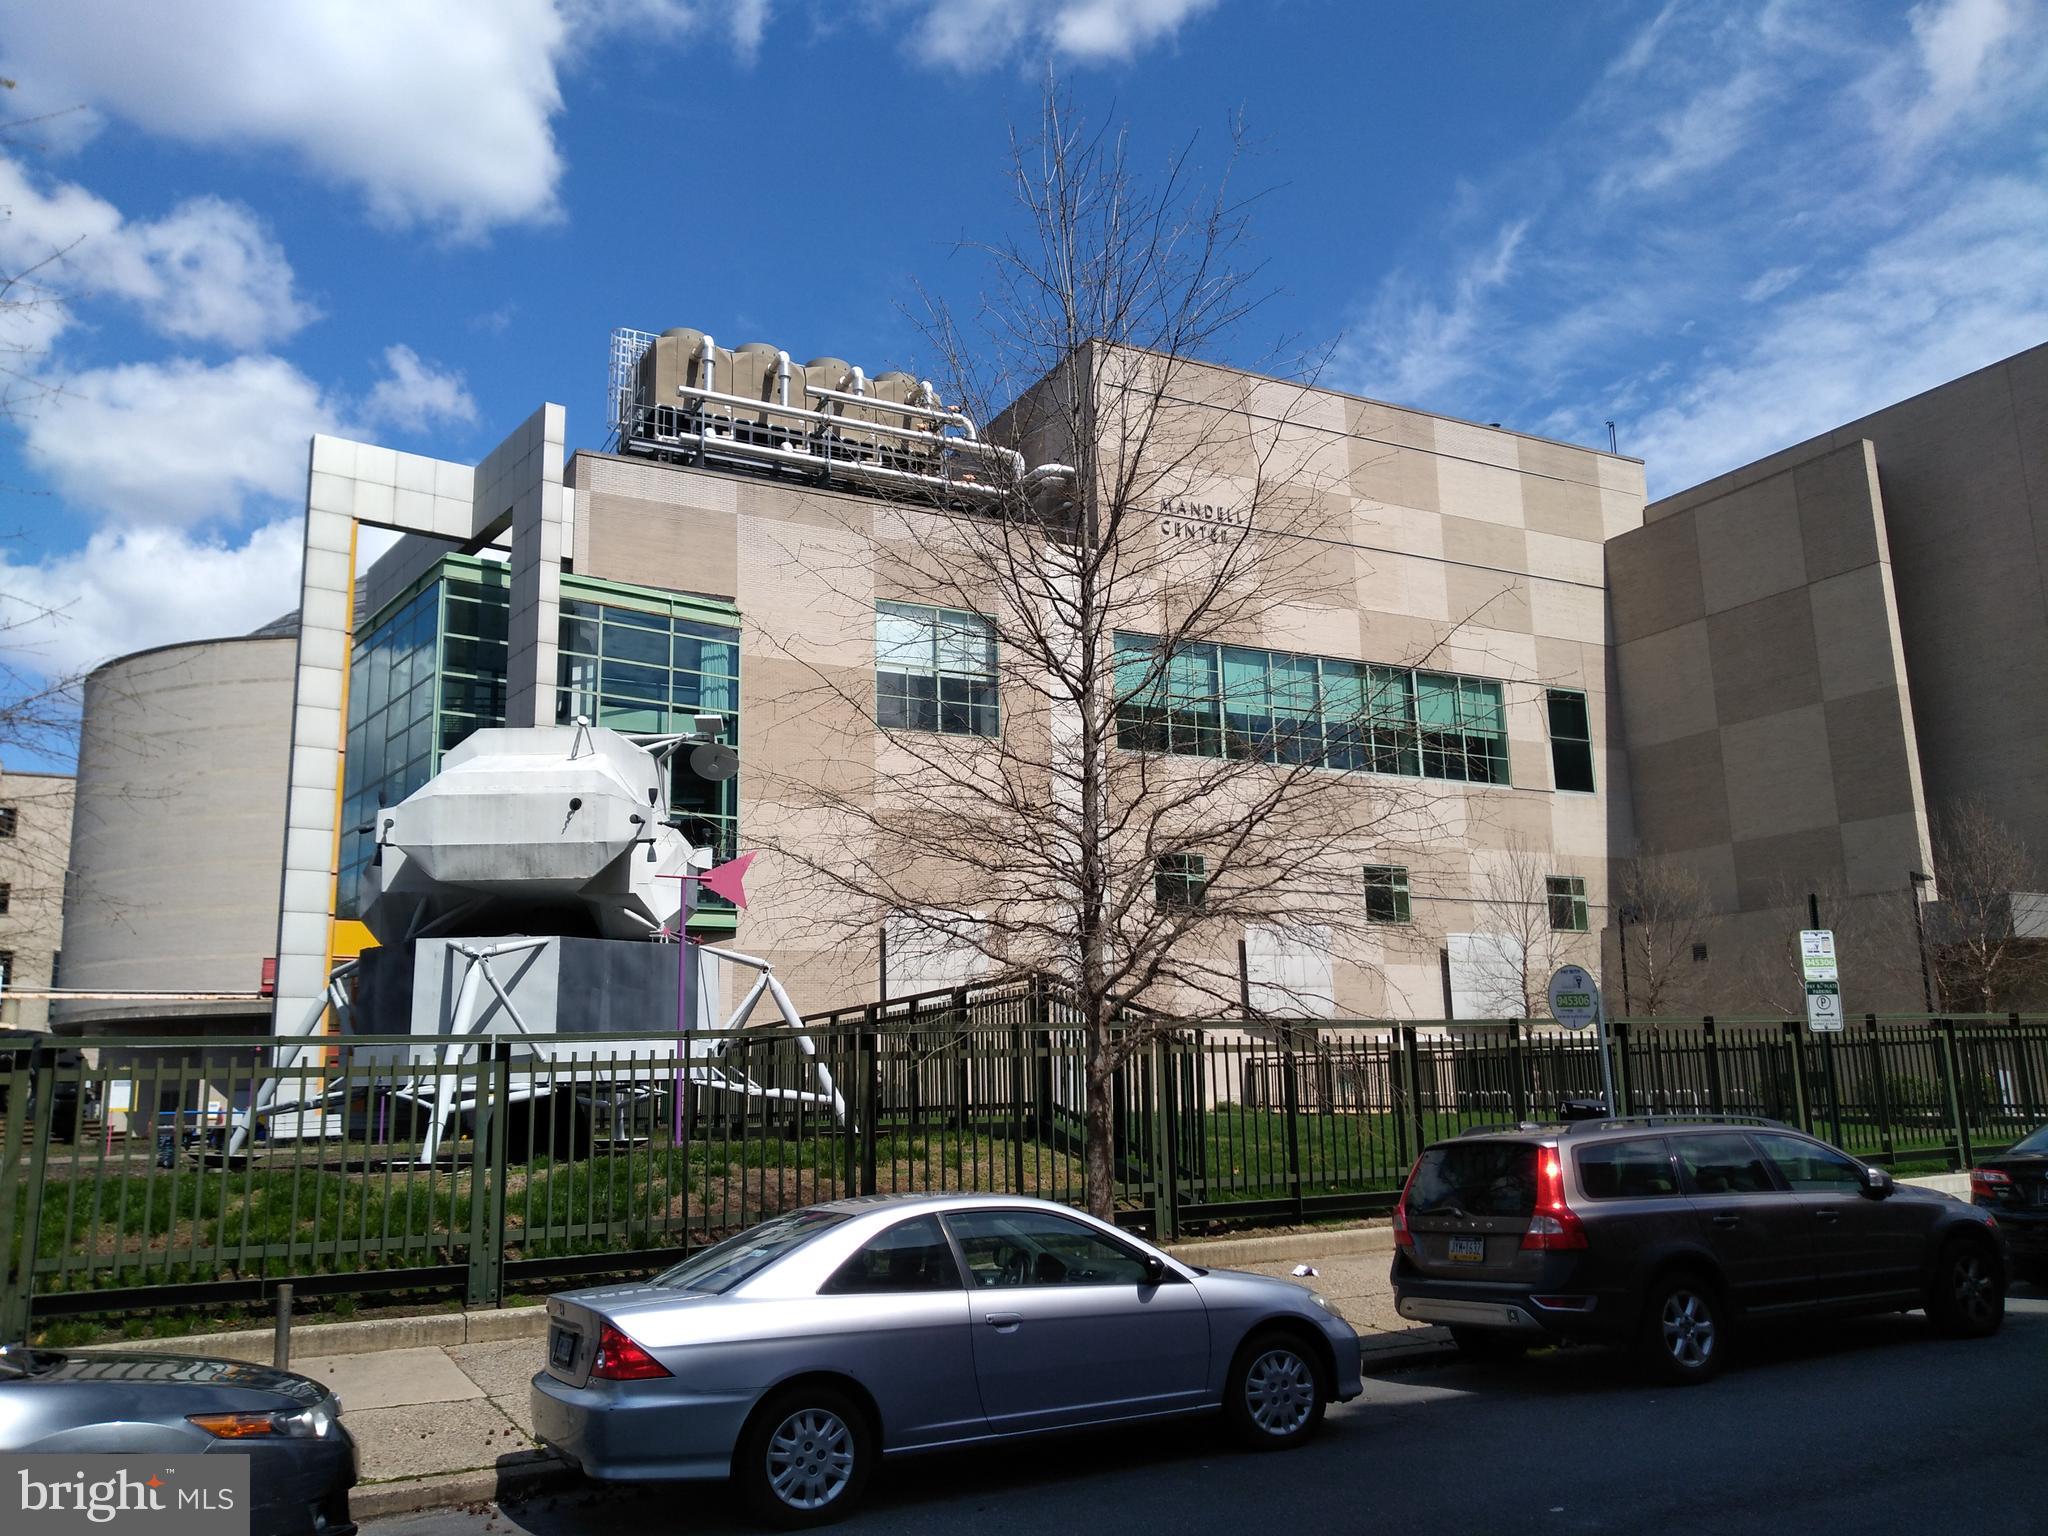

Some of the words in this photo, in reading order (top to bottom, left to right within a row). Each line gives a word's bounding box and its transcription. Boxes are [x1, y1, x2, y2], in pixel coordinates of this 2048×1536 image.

[1160, 497, 1242, 524] MANDELL
[1161, 520, 1228, 544] CENTER
[1805, 958, 1834, 967] 945306
[1557, 995, 1590, 1006] 945306
